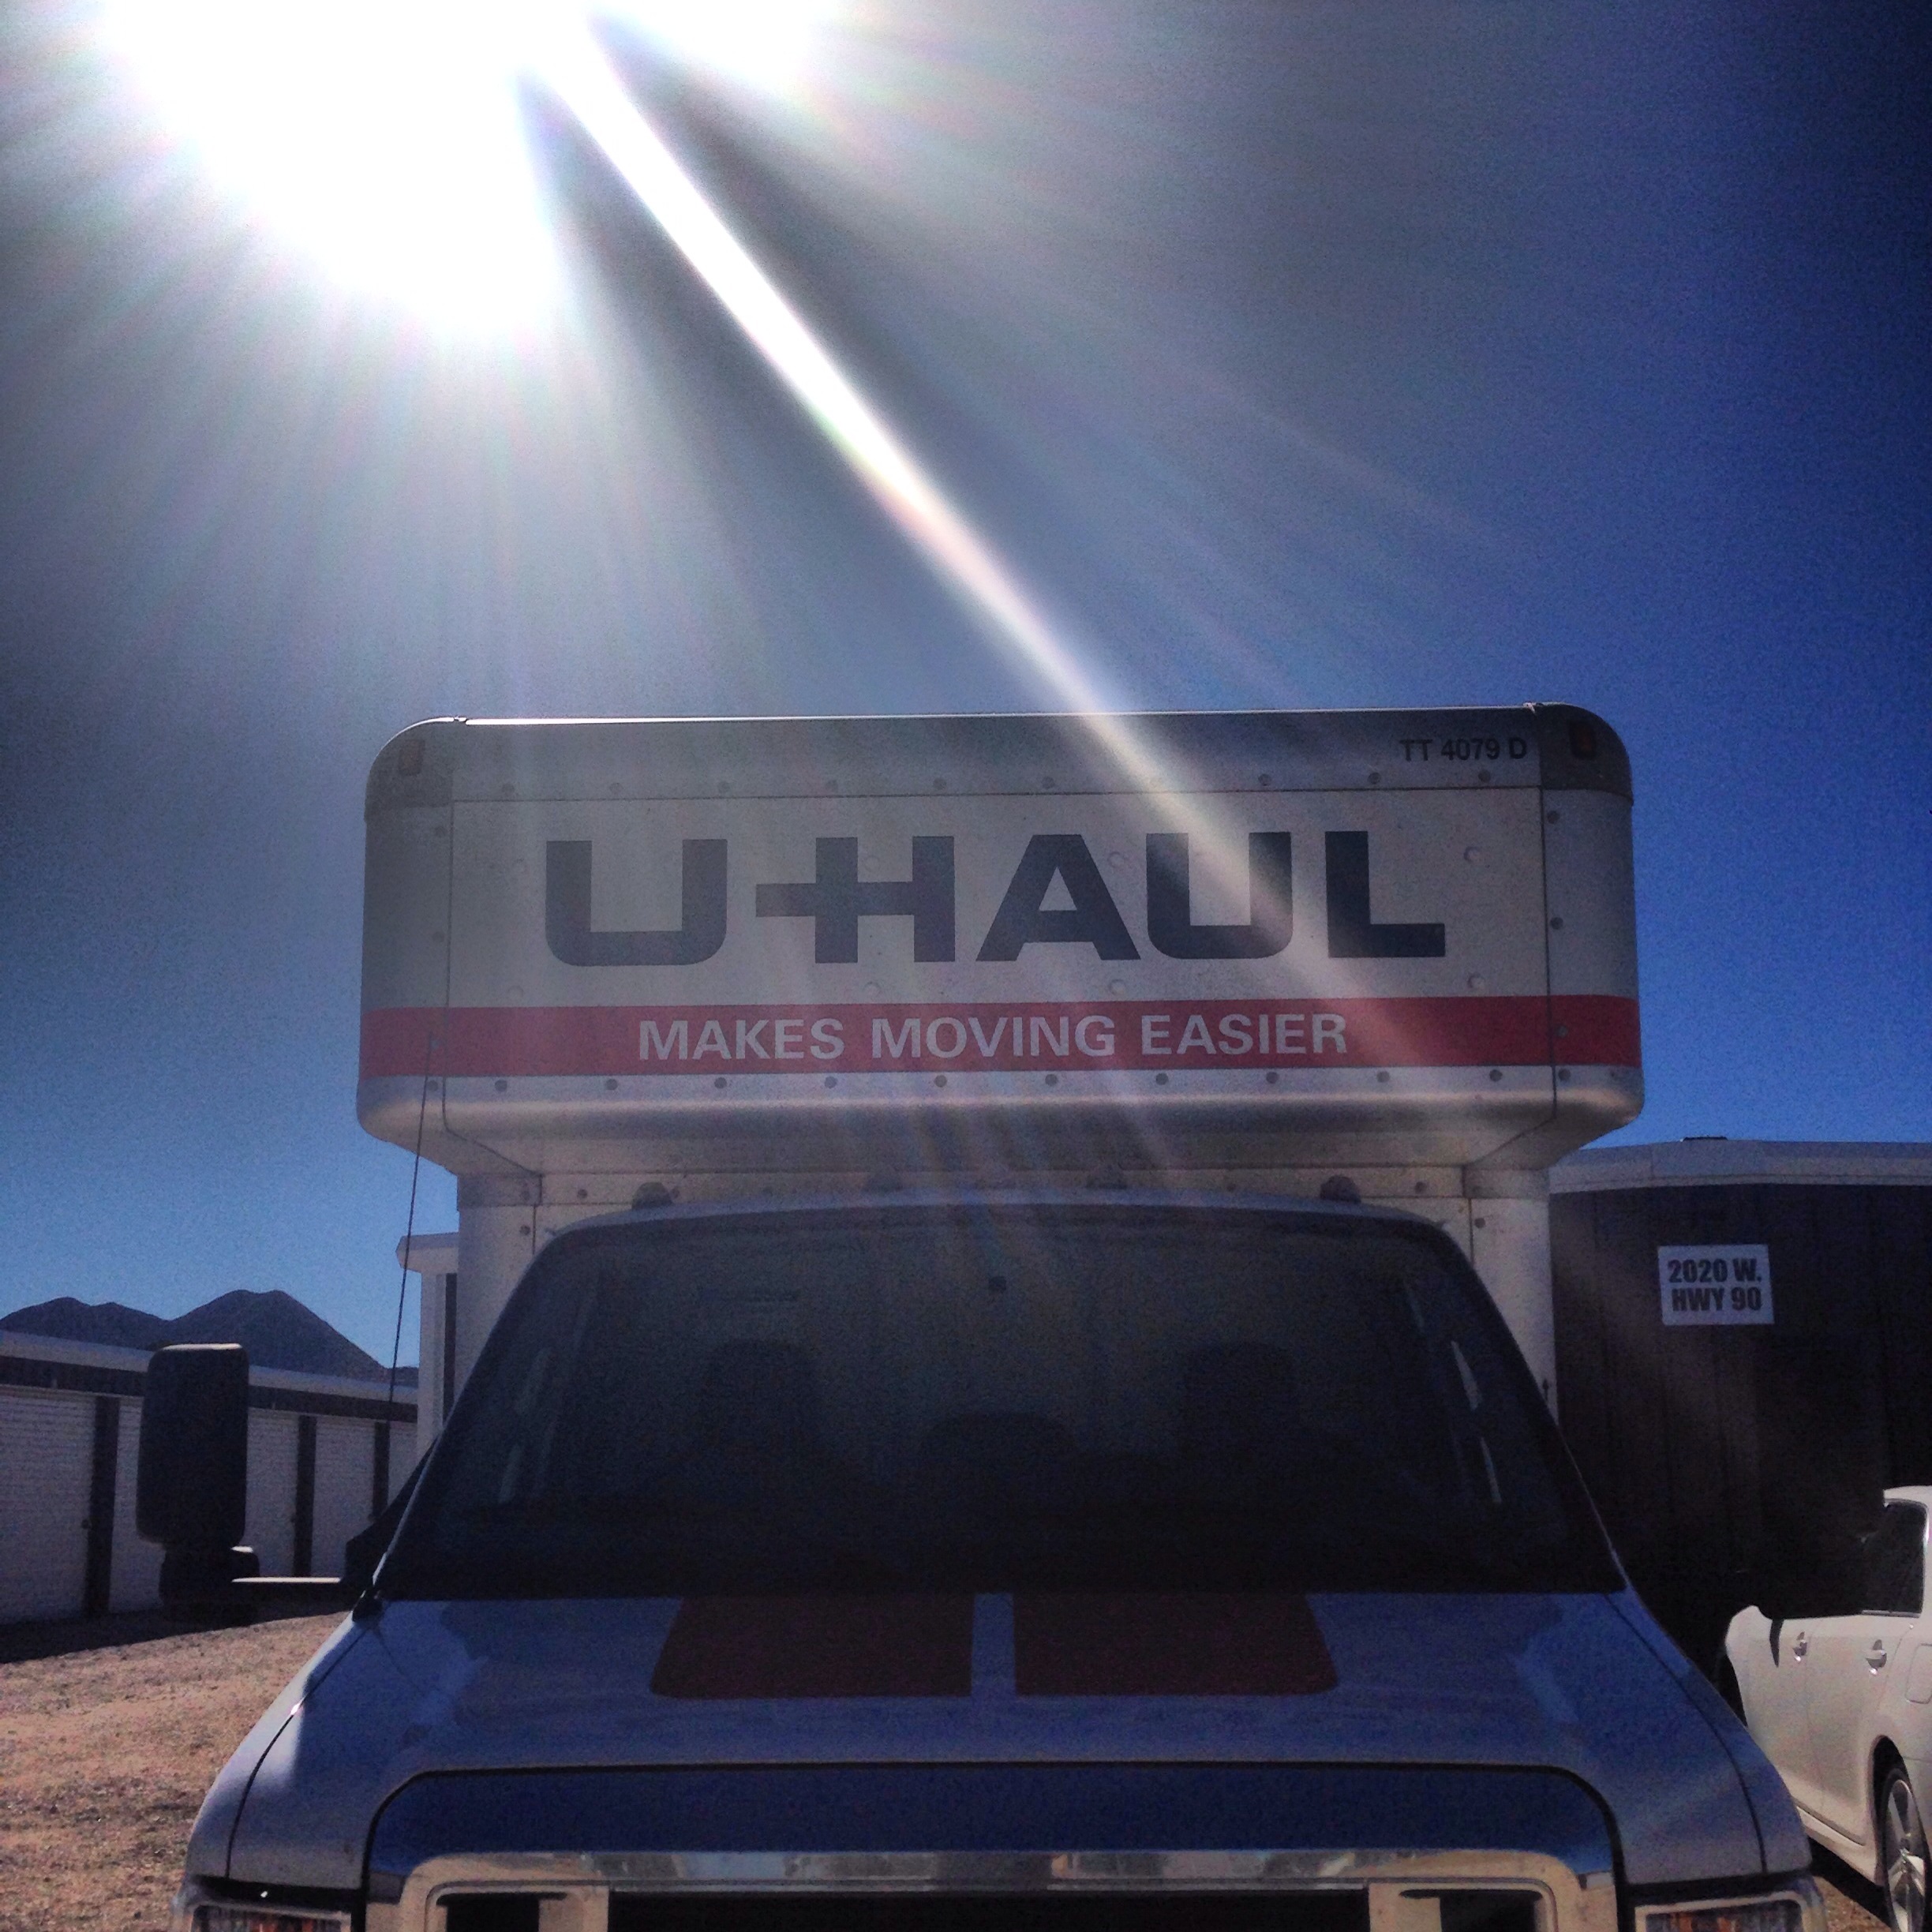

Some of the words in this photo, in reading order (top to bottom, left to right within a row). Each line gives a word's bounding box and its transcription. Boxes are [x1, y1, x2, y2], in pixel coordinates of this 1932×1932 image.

[1399, 739, 1433, 761] TT
[1441, 738, 1500, 760] 4079
[1508, 737, 1527, 759] D
[638, 1018, 845, 1061] MAKES
[871, 1014, 1116, 1058] MOVING
[1141, 1013, 1348, 1056] EASIER
[1668, 1259, 1728, 1283] 2020
[1732, 1259, 1762, 1282] W.
[1672, 1288, 1725, 1312] HWY
[1731, 1287, 1763, 1311] 90
